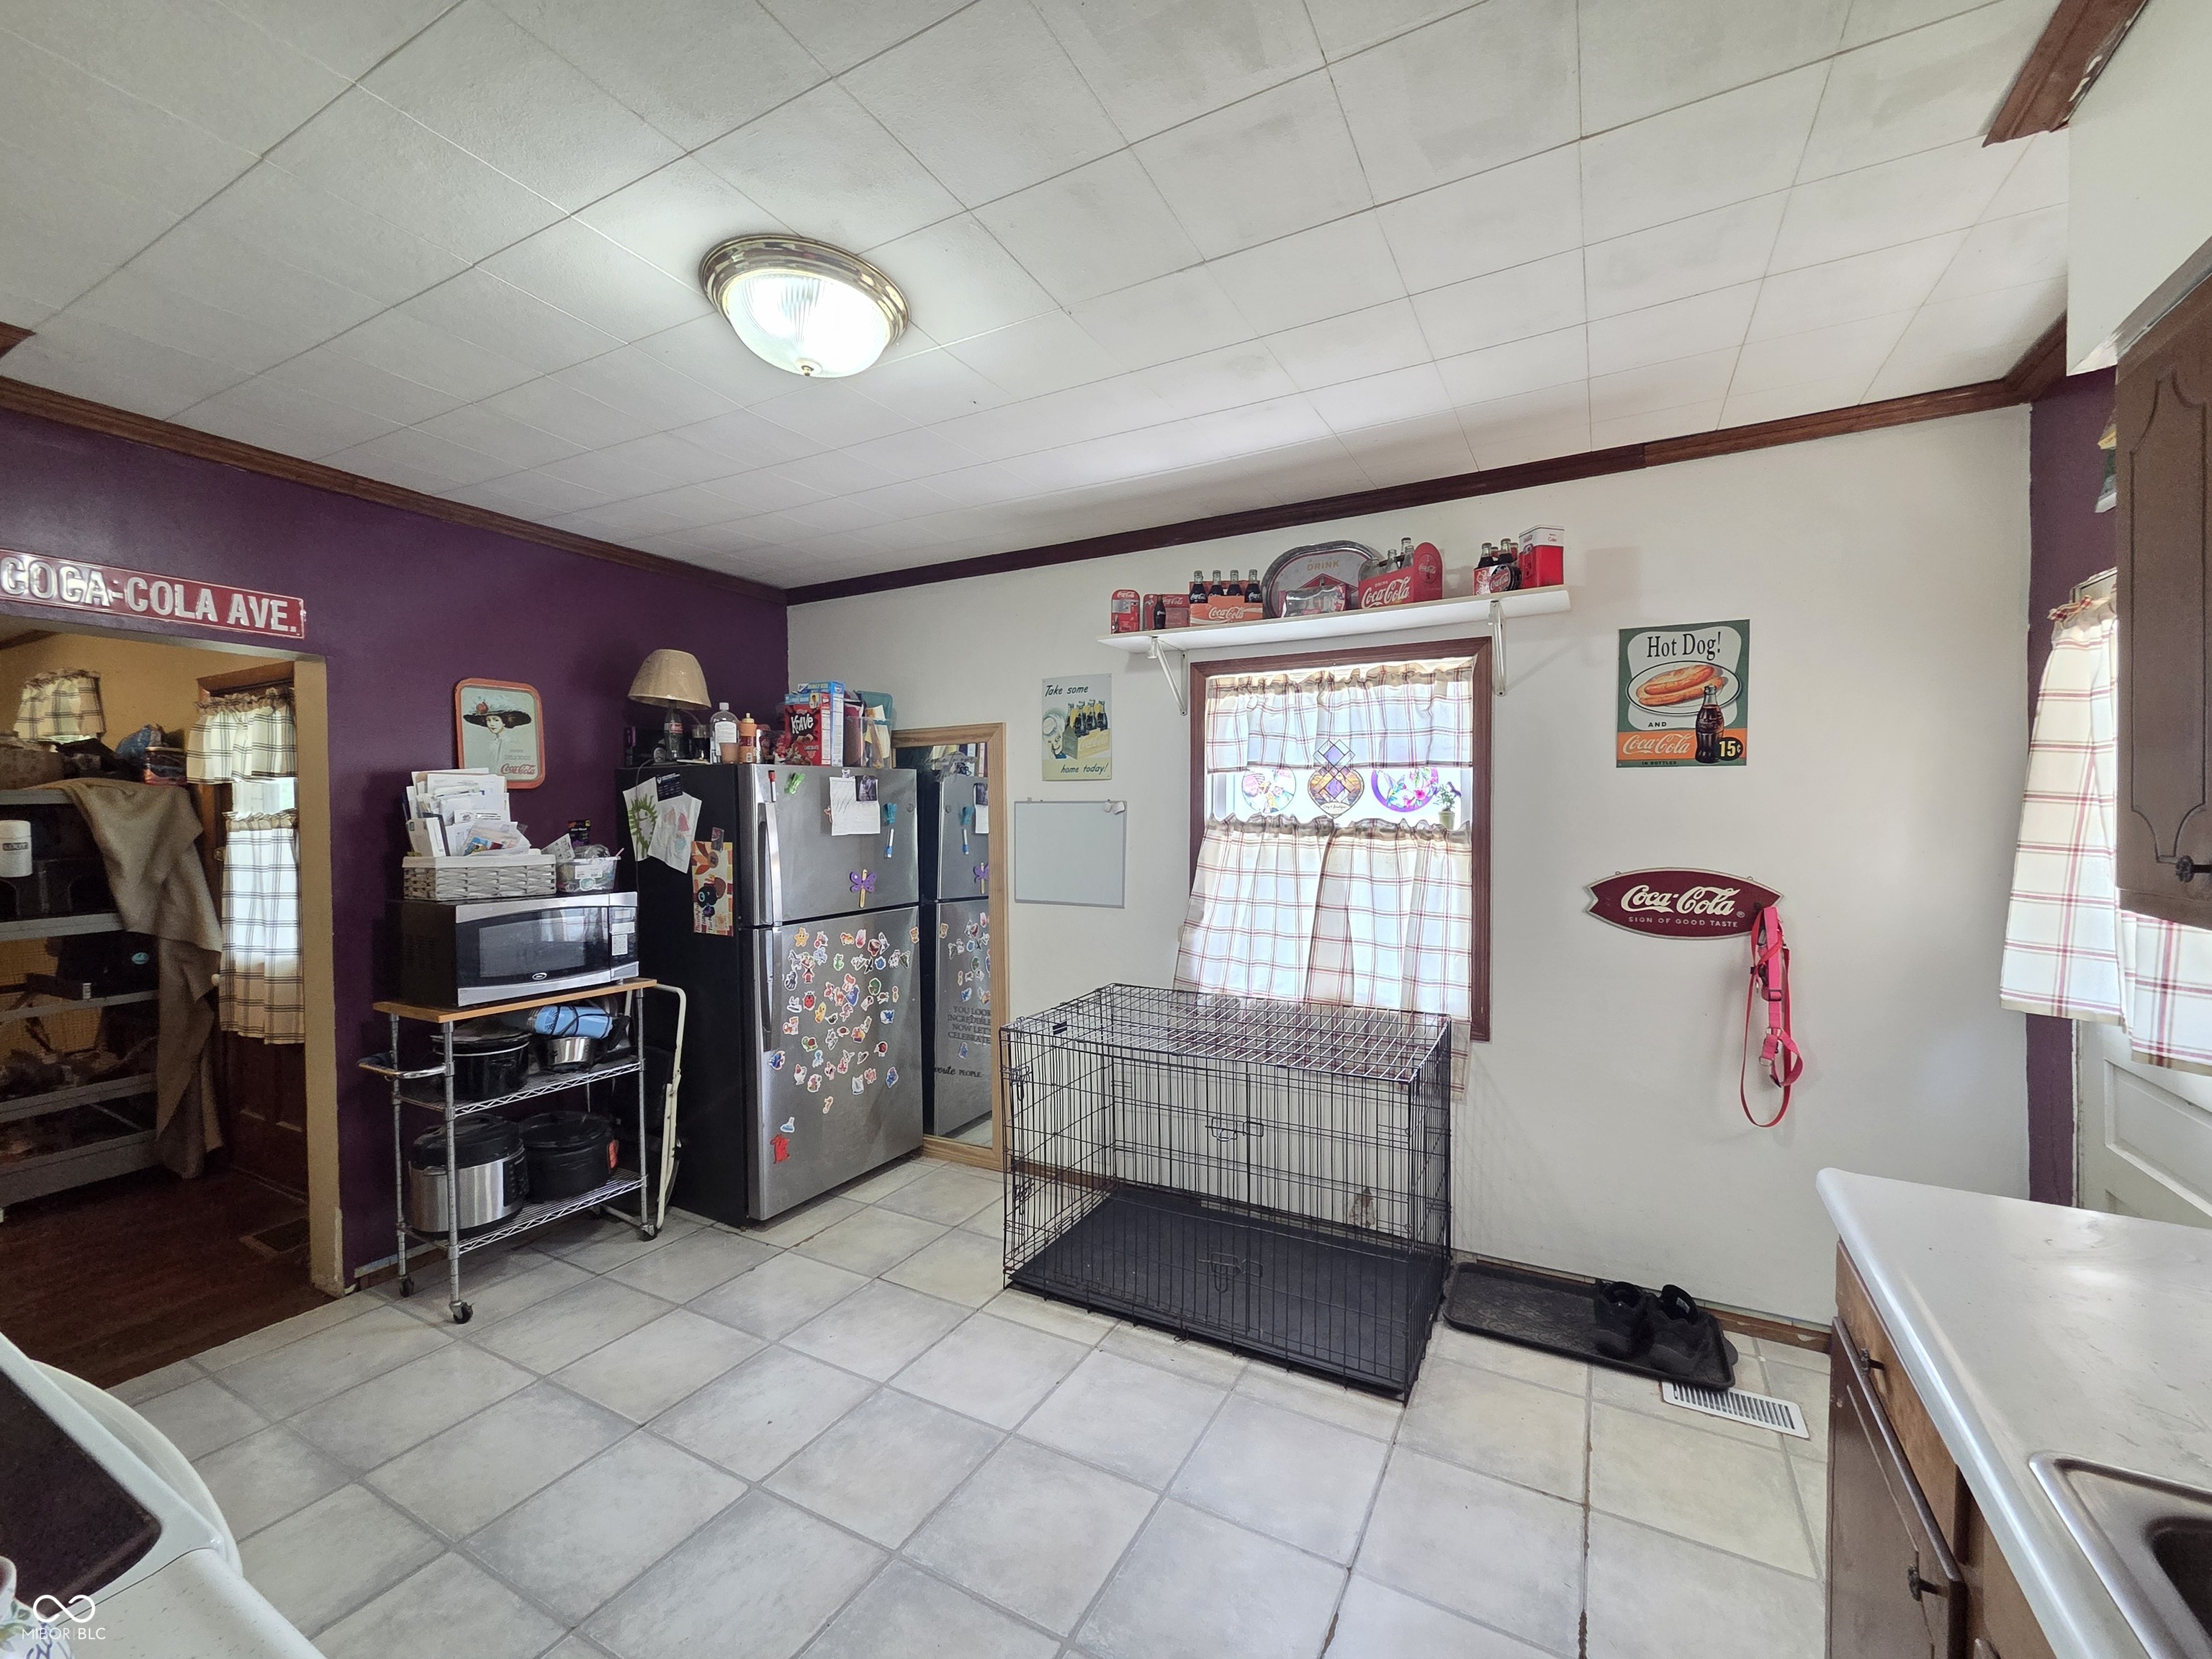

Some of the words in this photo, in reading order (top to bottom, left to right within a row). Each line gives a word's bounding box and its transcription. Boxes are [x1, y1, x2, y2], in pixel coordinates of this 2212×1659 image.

[1306, 560, 1340, 571] DRINK
[0, 557, 218, 622] COCA-COLA
[227, 593, 297, 634] AVE.
[1361, 576, 1411, 608] Coca-Cola
[1209, 606, 1244, 619] Coca-Cola
[1647, 636, 1677, 657] Hot
[1682, 631, 1722, 660] Dog!
[1045, 685, 1064, 697] Take
[1067, 685, 1089, 695] some
[1622, 733, 1694, 755] Coca-Cola
[500, 763, 536, 775] Coca-Cola
[1061, 764, 1079, 773] home
[1083, 763, 1109, 775] today!
[1621, 884, 1741, 916] Coca-Cola
[953, 1006, 970, 1015] YOU
[948, 1014, 991, 1025] INCREDIBLE
[952, 1023, 971, 1033] NOW
[948, 1031, 991, 1044] CELEBRATE
